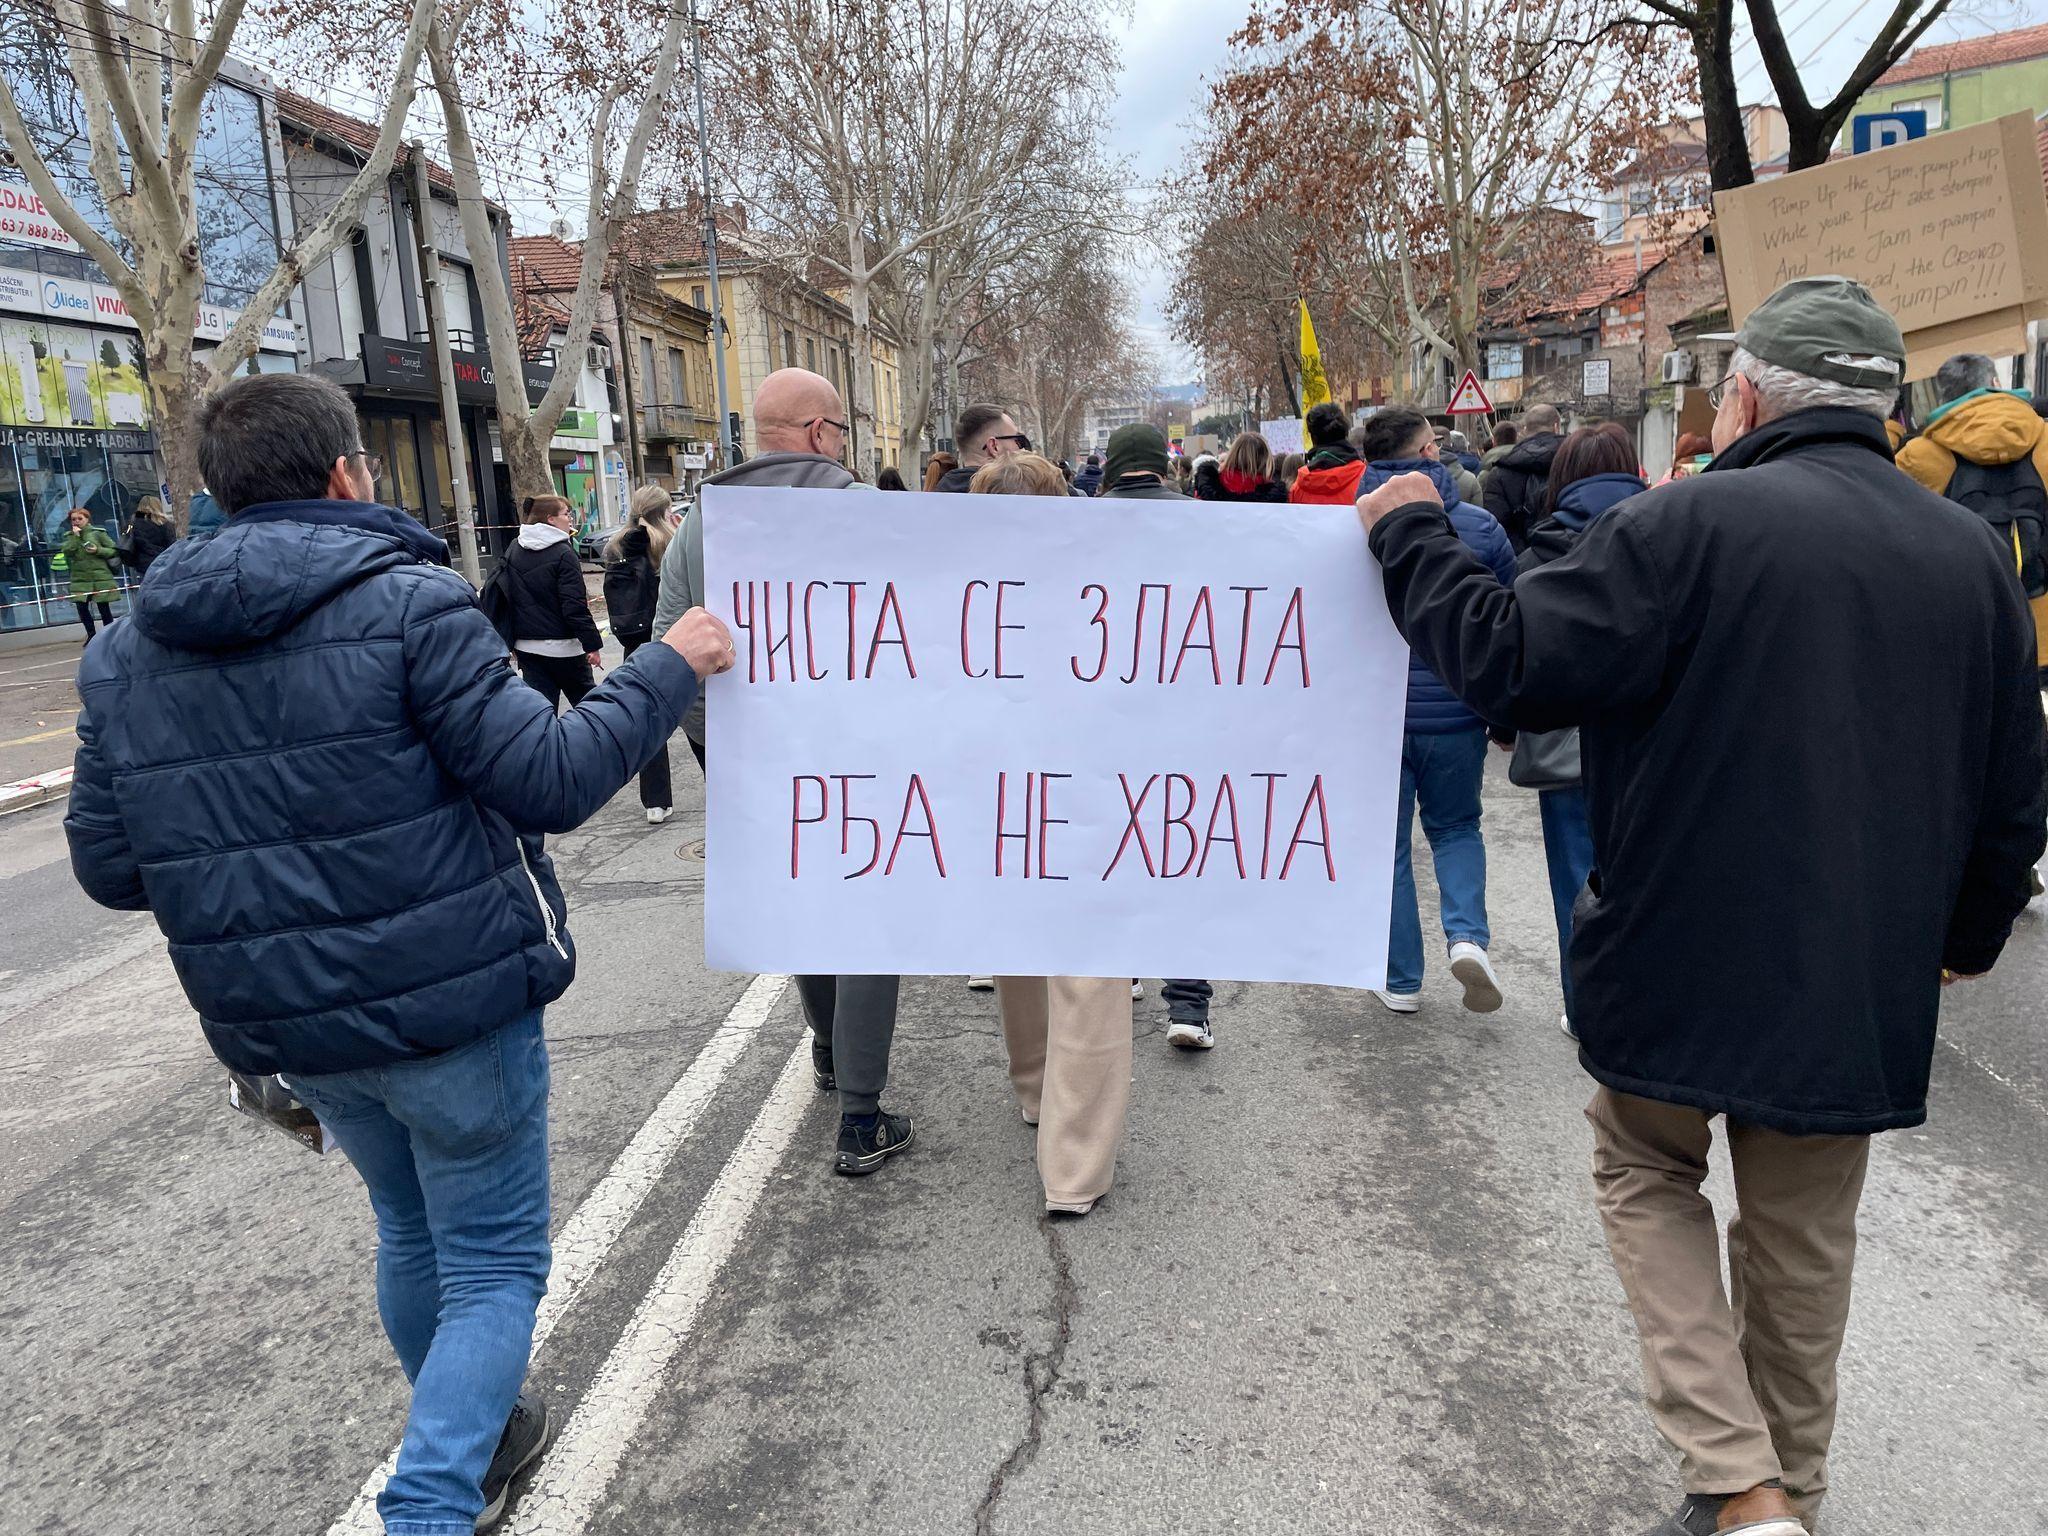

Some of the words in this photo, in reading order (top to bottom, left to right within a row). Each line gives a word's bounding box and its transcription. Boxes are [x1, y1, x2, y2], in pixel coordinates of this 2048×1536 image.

[1768, 196, 1810, 218] Pump
[1817, 183, 1838, 210] Up
[1844, 175, 1868, 192] the
[1963, 146, 1975, 165] it
[0, 217, 17, 233] 63
[18, 221, 24, 234] 7
[28, 224, 48, 239] 888
[51, 228, 69, 243] 255
[1763, 222, 1809, 250] While
[1860, 188, 1900, 231] feet
[1773, 254, 1808, 287] And
[1825, 245, 1856, 266] the
[1865, 229, 1911, 264] Jam
[1922, 222, 1935, 242] is
[1905, 257, 1935, 277] the
[45, 281, 89, 310] Midea
[96, 296, 129, 316] VIVA
[203, 311, 218, 328] LG
[454, 361, 480, 383] TARA
[25, 431, 88, 448] GREJANJE
[732, 580, 918, 683] ЧИСТА
[960, 579, 1026, 679] СЕ
[1071, 583, 1311, 689] ЗЛАТА
[791, 773, 947, 881] РЂА
[995, 771, 1073, 881] НЕ
[1102, 772, 1337, 882] ХВАТА
